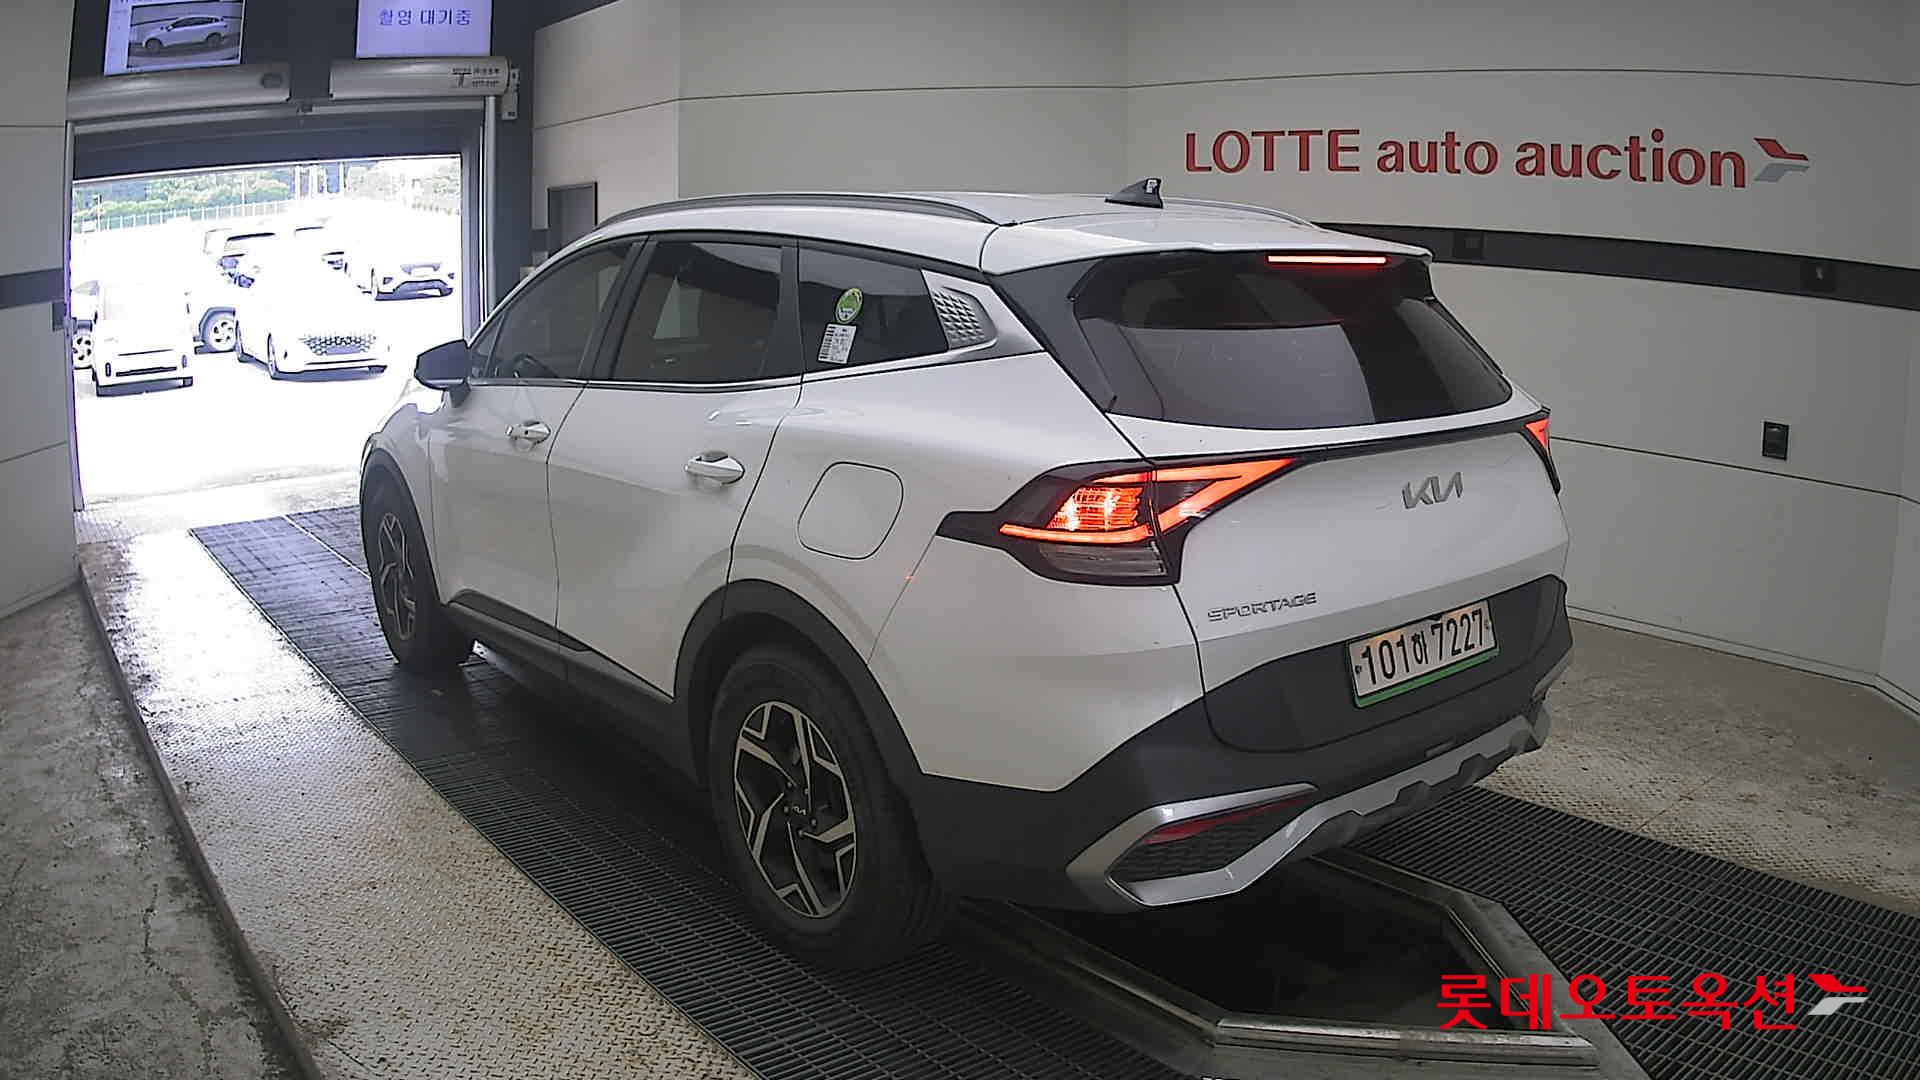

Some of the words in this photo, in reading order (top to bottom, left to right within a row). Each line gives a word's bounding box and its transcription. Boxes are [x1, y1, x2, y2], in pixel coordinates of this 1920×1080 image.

[420, 8, 471, 26] 대기중
[1185, 129, 1361, 173] LOTTE
[1376, 131, 1499, 175] auto
[1514, 128, 1746, 189] auction
[1401, 471, 1463, 510] KIA
[1207, 592, 1317, 622] SPORTAGE
